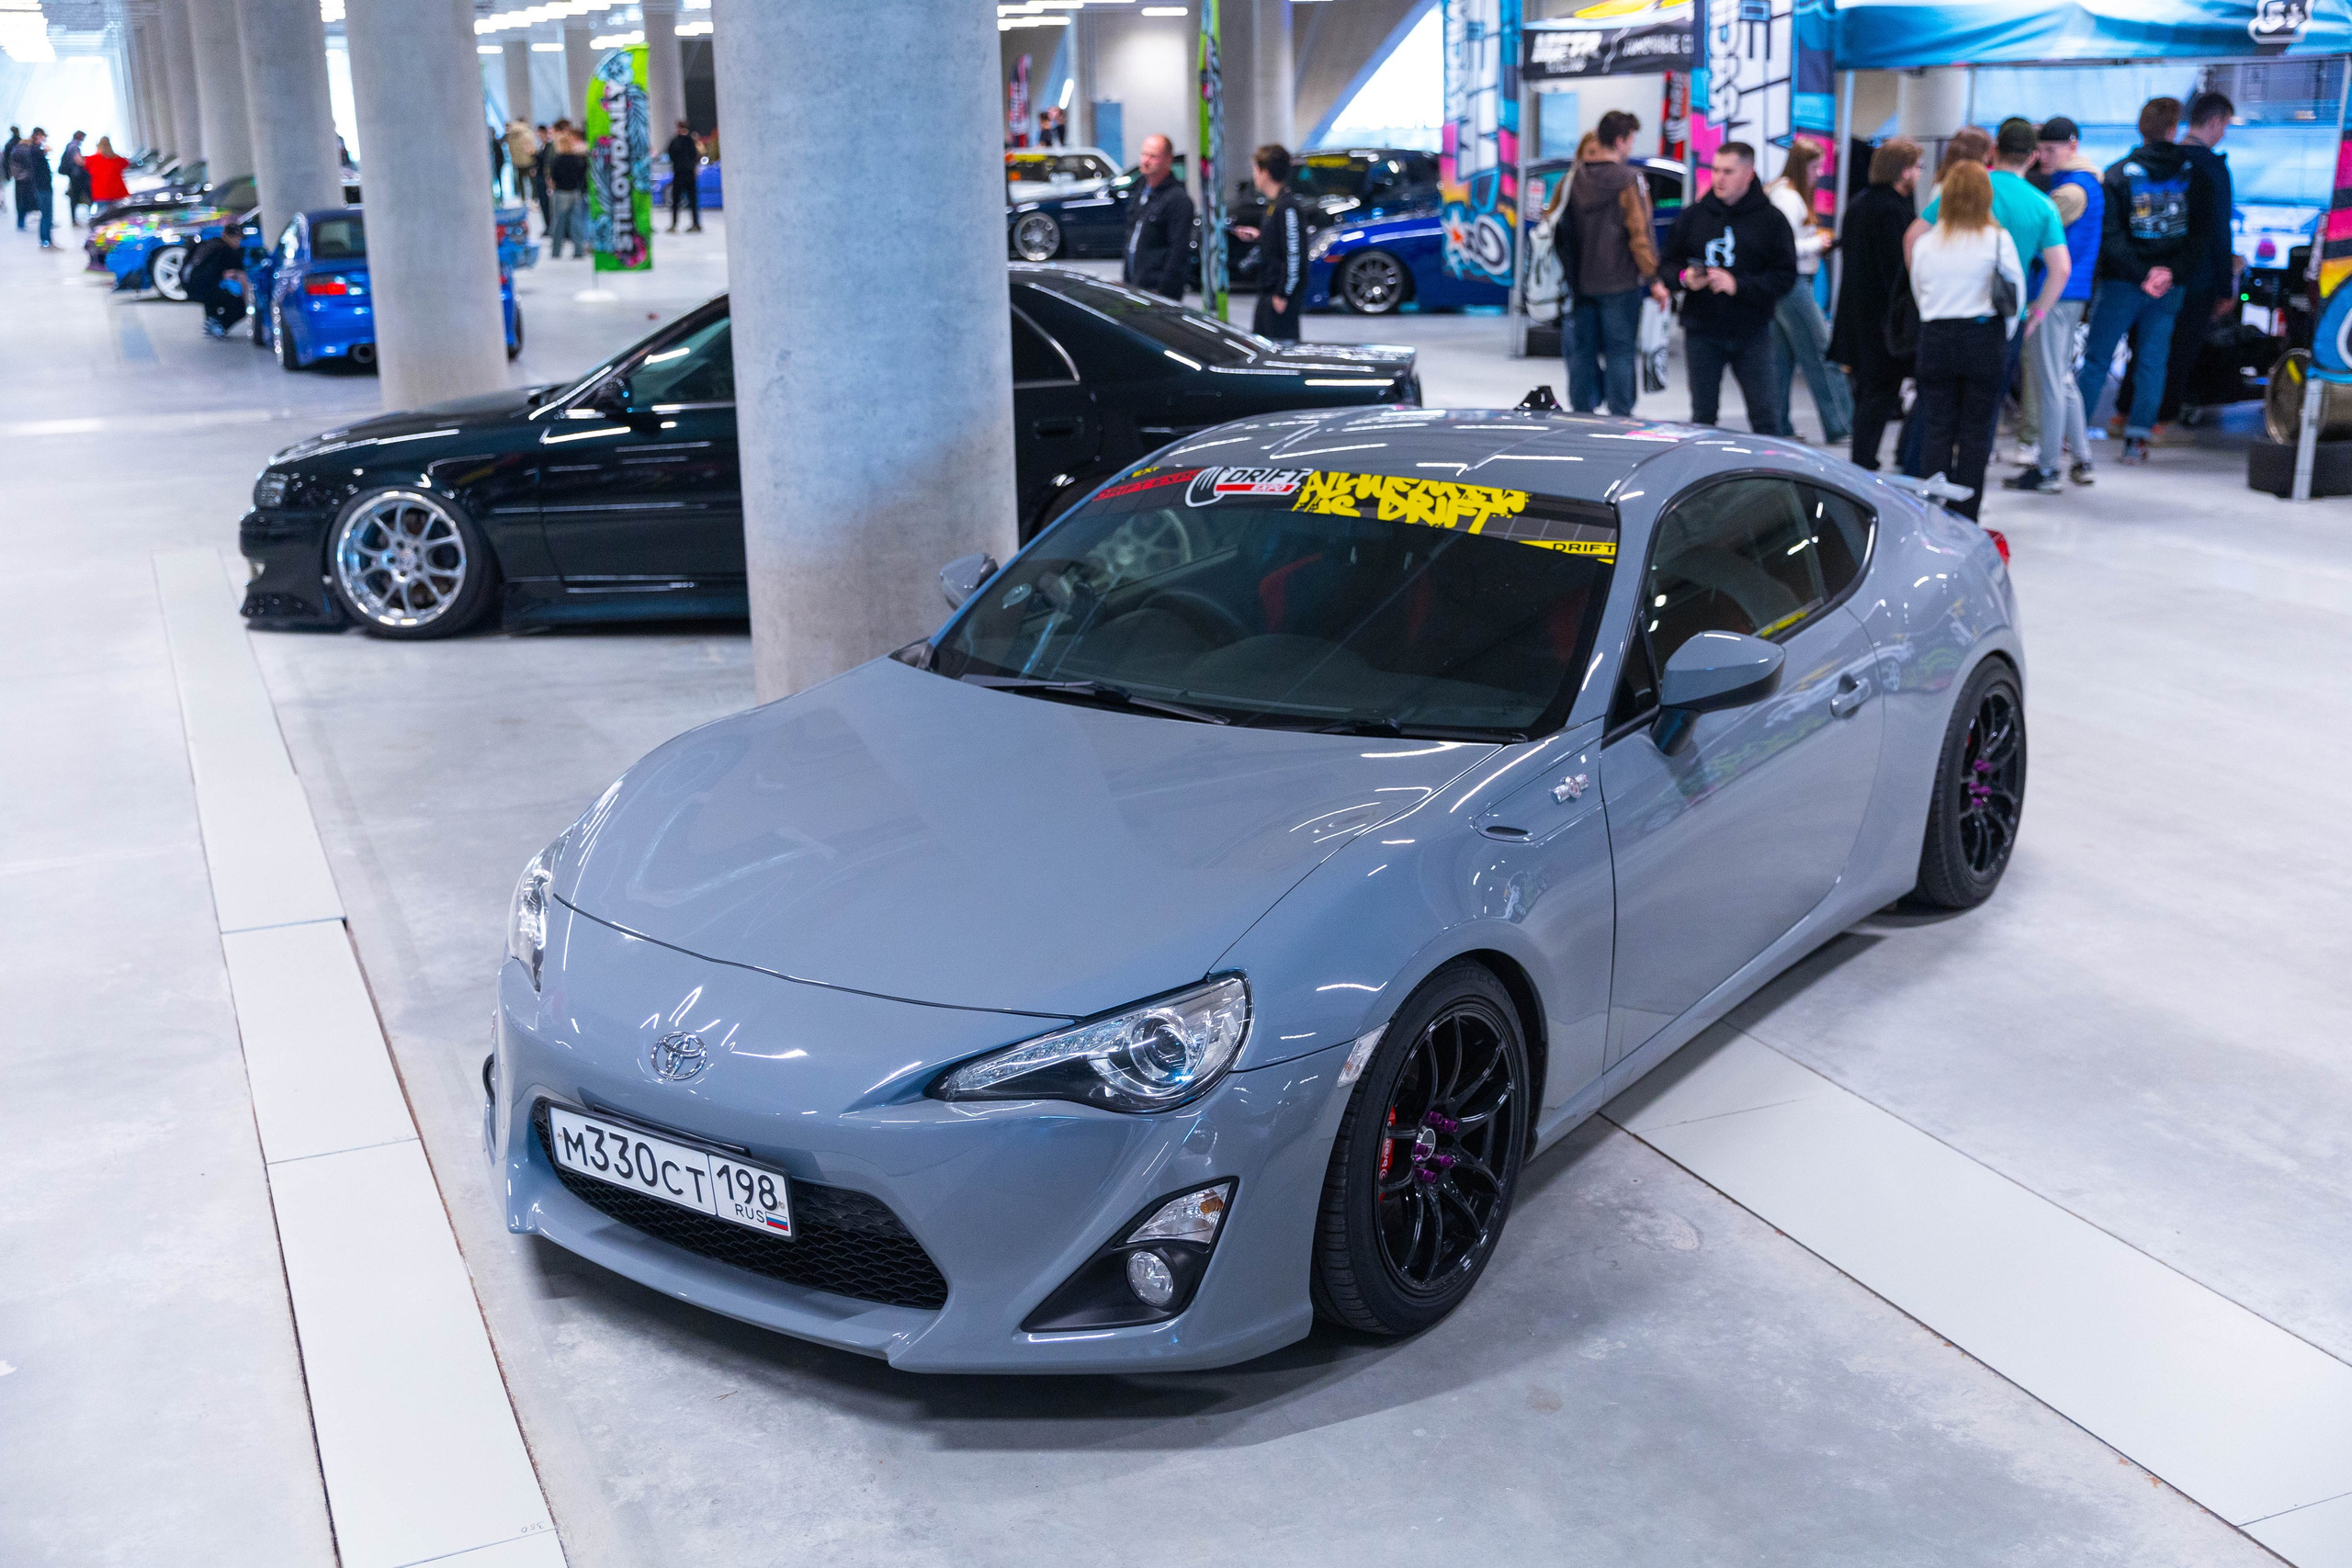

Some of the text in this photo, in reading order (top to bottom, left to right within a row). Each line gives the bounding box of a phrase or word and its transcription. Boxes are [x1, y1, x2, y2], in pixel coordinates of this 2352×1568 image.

[1224, 468, 1311, 483] DRIFT
[1251, 484, 1285, 492] EXPO
[1552, 543, 1617, 553] DRIFT
[562, 1123, 778, 1212] M330CT 198
[735, 1203, 765, 1224] RUS
